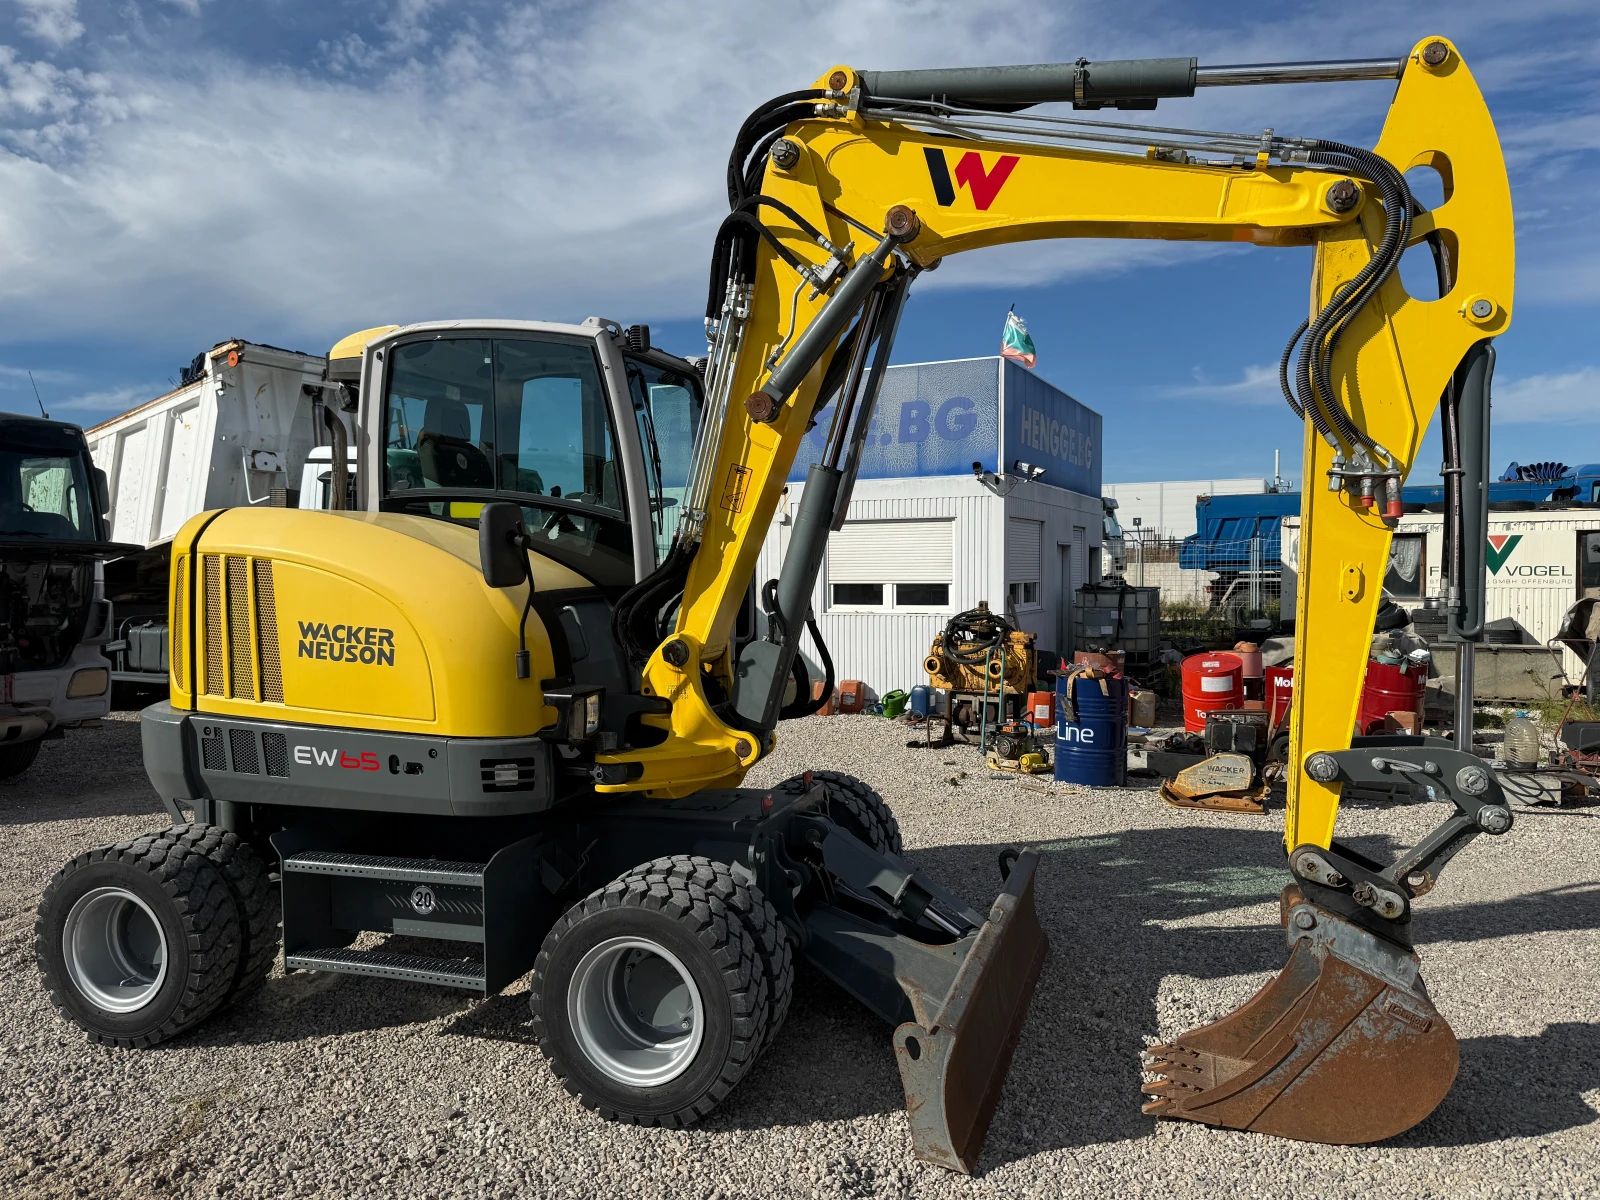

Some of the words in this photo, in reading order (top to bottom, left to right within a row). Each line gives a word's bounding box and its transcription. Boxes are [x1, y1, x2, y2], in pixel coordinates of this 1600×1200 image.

[1020, 404, 1093, 470] HENGGE.BG
[1505, 565, 1573, 577] VOGEL
[298, 620, 395, 648] WACKER
[298, 639, 395, 667] NEUSON
[1055, 720, 1095, 744] Line
[293, 745, 381, 772] EW65
[1207, 764, 1245, 775] WACKER
[415, 891, 432, 908] 20
